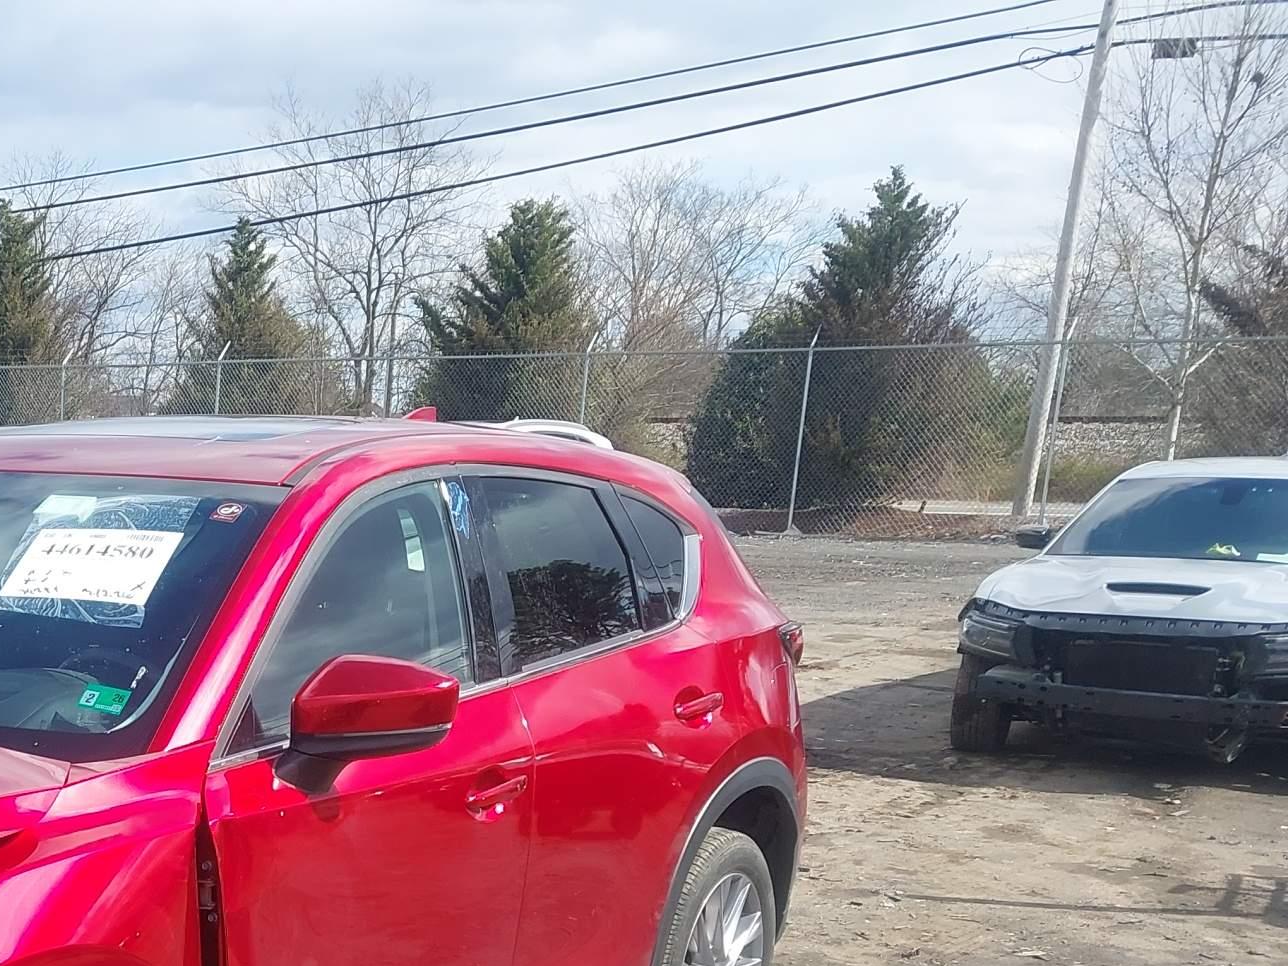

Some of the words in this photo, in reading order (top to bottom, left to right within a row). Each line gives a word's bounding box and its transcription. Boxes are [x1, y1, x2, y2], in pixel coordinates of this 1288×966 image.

[41, 544, 154, 559] 44614580
[84, 693, 96, 703] 2
[112, 693, 126, 703] 26
